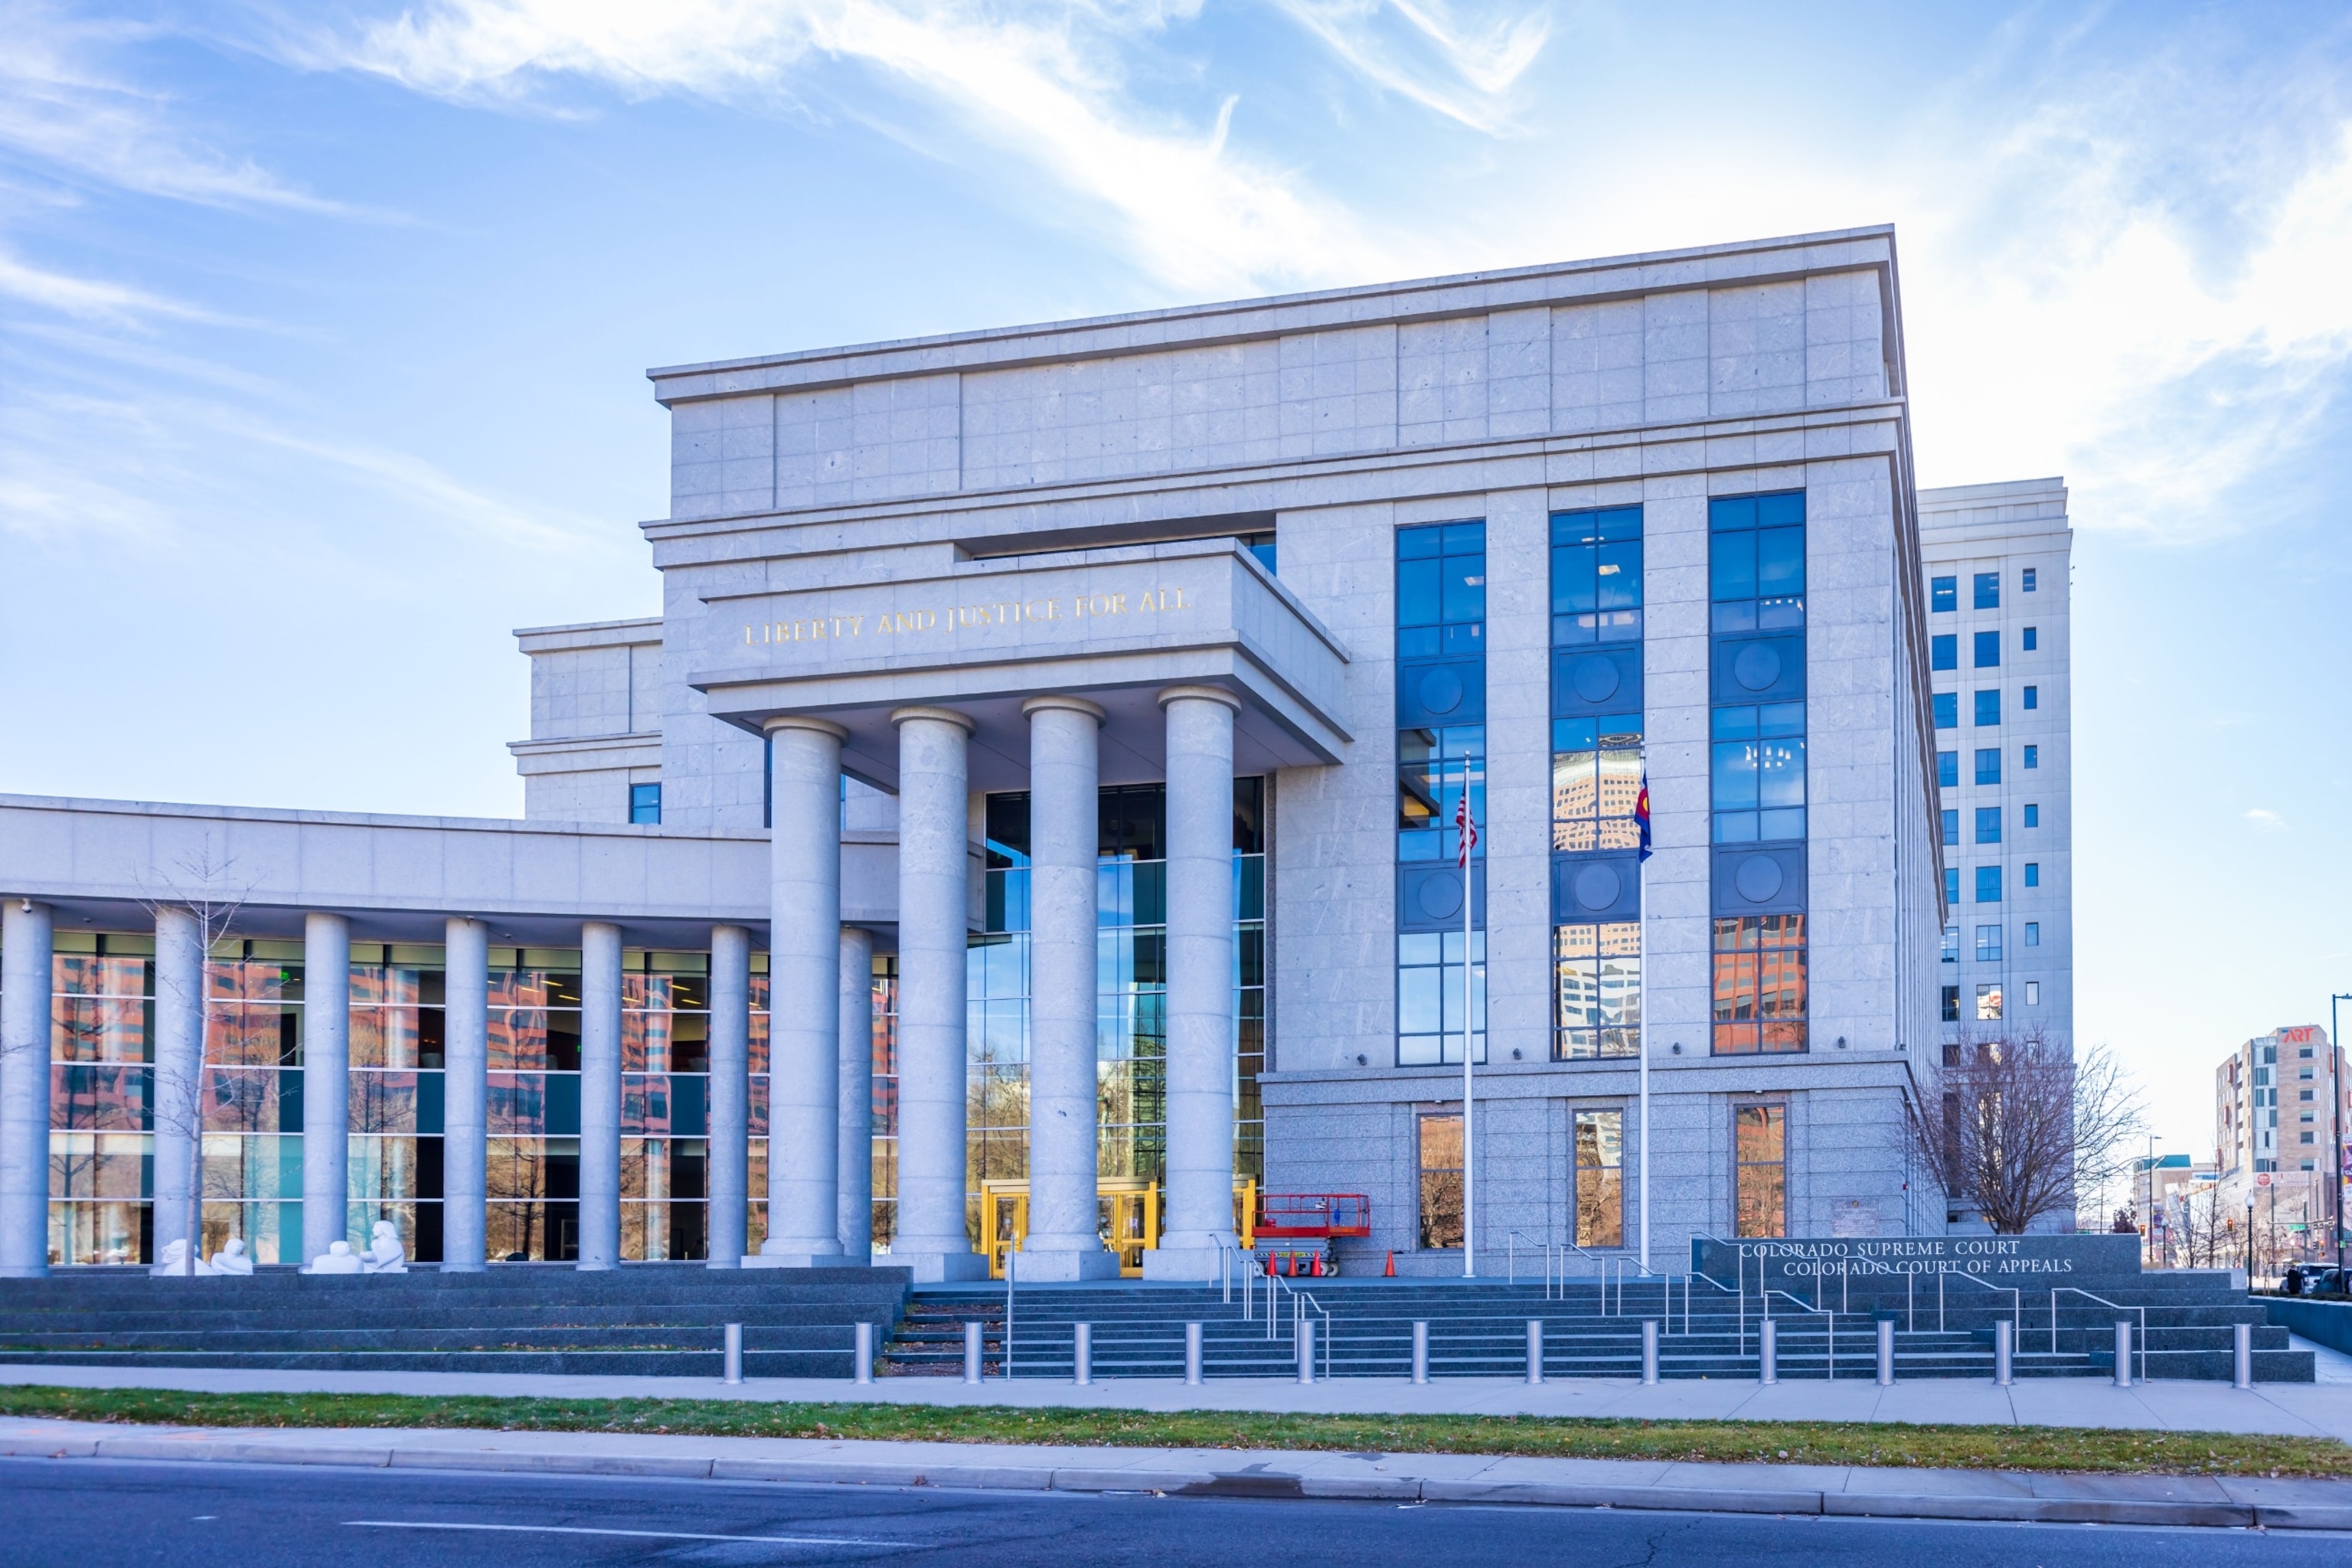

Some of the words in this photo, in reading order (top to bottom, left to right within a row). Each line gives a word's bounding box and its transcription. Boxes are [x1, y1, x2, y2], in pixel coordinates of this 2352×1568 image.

[745, 615, 864, 645] LIBERTY
[877, 609, 936, 635] AND
[944, 598, 1063, 635] JUSTICE
[1075, 593, 1129, 619] FOR
[1139, 588, 1191, 613] ALL
[2283, 1027, 2314, 1043] ART
[1740, 1243, 1848, 1258] COLORADO
[1857, 1242, 1945, 1256] SUPREME
[1955, 1240, 2020, 1255] COURT
[1783, 1261, 1890, 1276] COLORADO
[1896, 1259, 1961, 1274] COURT
[1967, 1259, 1991, 1273] OF
[1998, 1259, 2073, 1272] APPEALS
